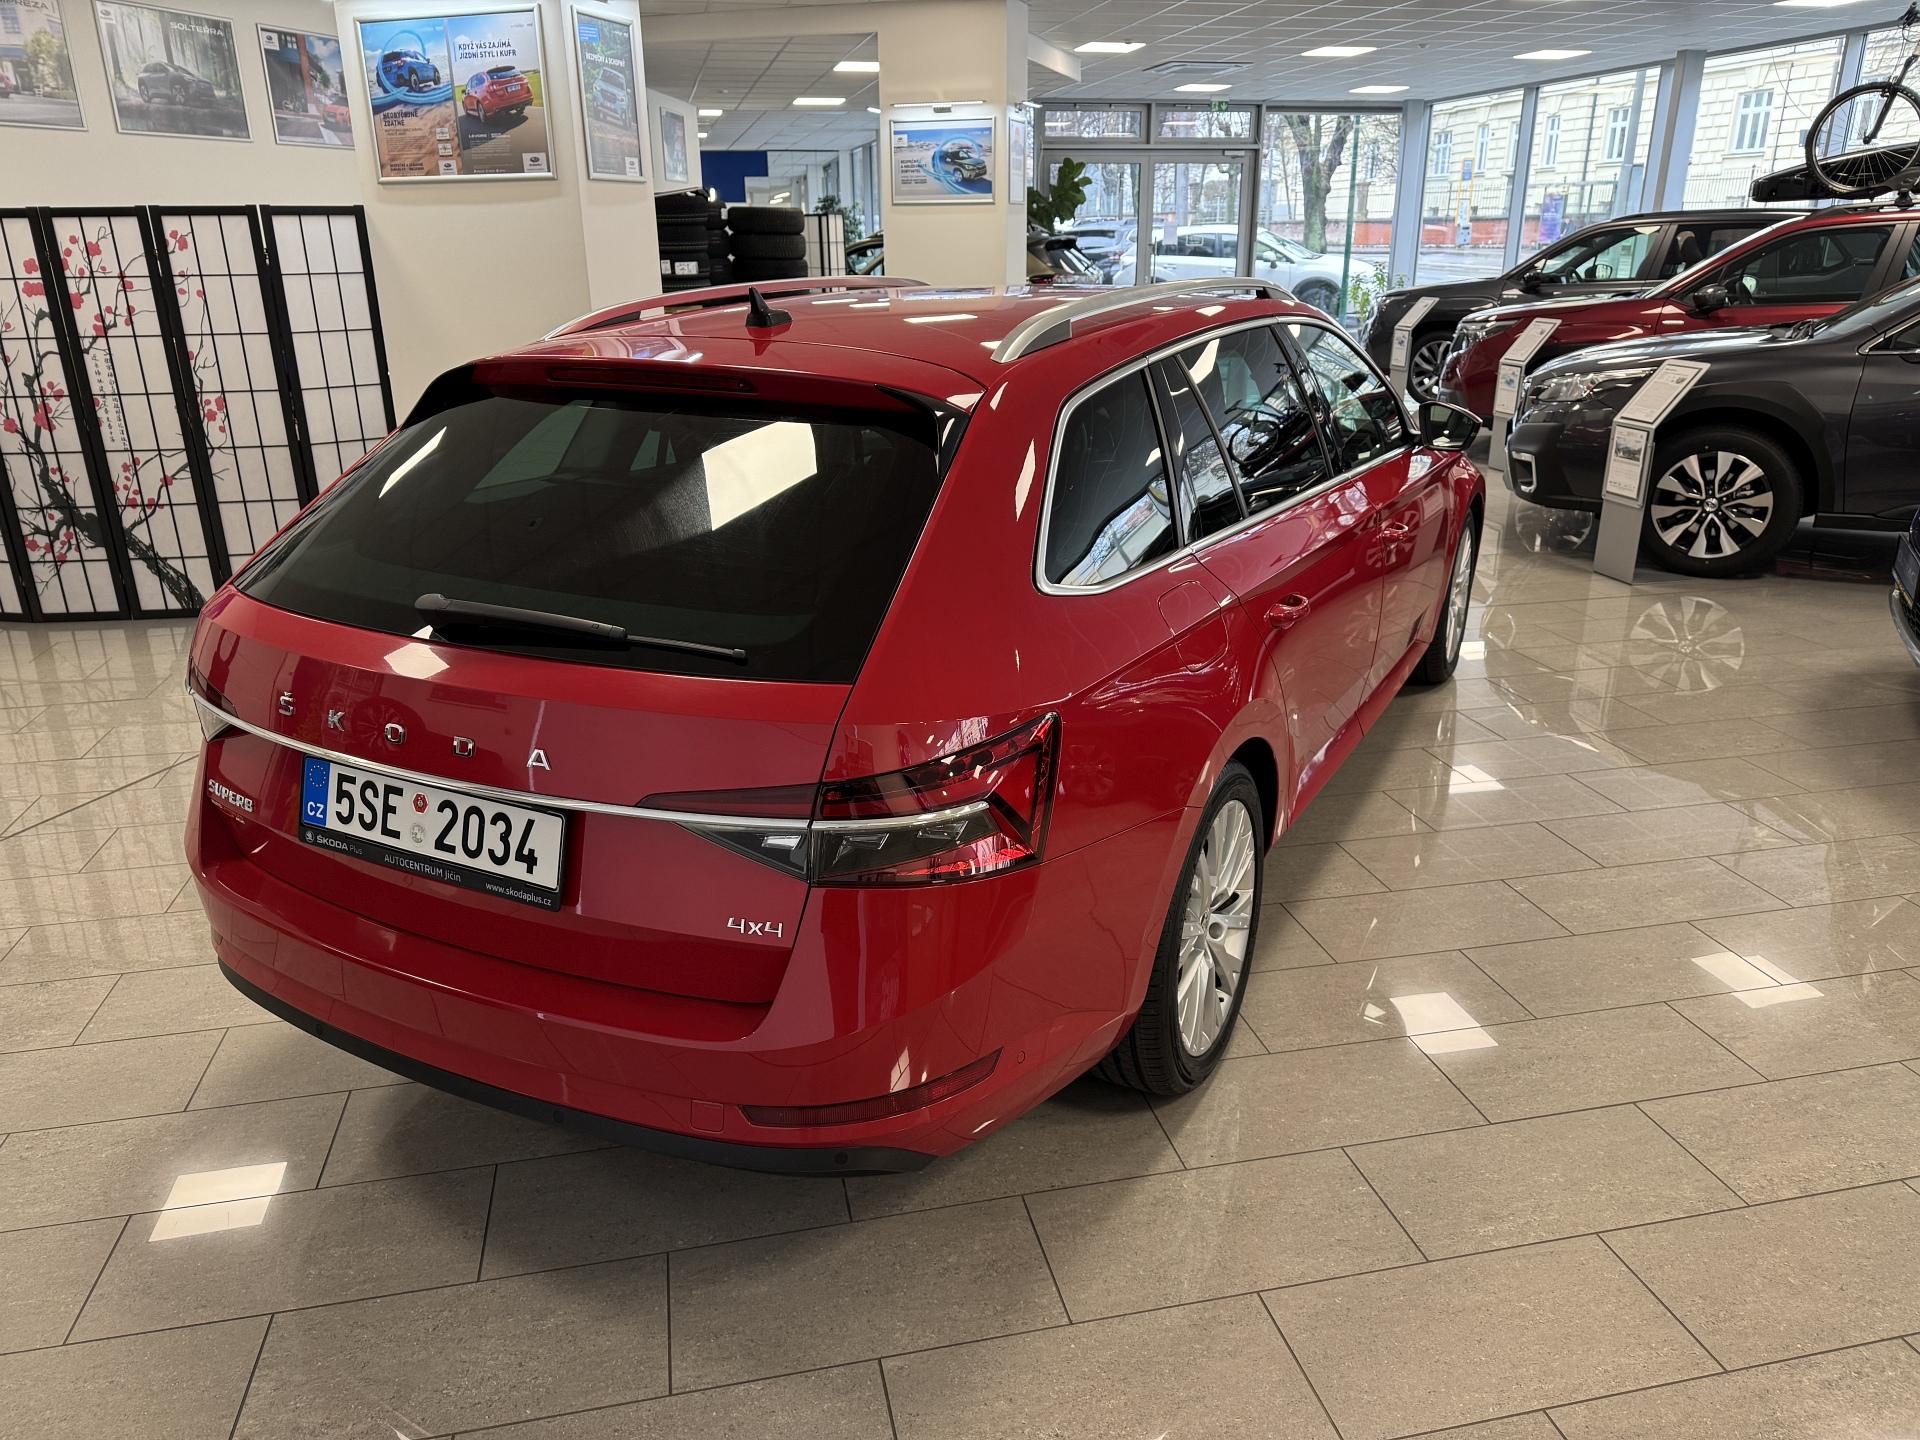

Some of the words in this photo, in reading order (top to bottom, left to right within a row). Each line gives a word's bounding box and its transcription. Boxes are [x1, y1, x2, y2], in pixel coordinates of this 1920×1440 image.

[169, 21, 224, 37] SOLTERRA
[458, 40, 475, 51] KDYŽ
[475, 40, 487, 50] VÁS
[488, 38, 512, 49] ZAJÍMÁ
[480, 50, 494, 58] STYL
[499, 48, 517, 57] KUFR
[278, 690, 551, 771] ŠKODA
[208, 778, 253, 813] SUPERB
[307, 801, 325, 819] CZ
[335, 772, 404, 840] 5SE
[434, 799, 538, 875] 2034
[316, 835, 349, 852] ŠKODA
[349, 843, 363, 856] Plus
[384, 854, 443, 878] AUTOCENTRUM
[485, 882, 552, 906] www.skodaplus.cz
[727, 917, 783, 938] 4x4
